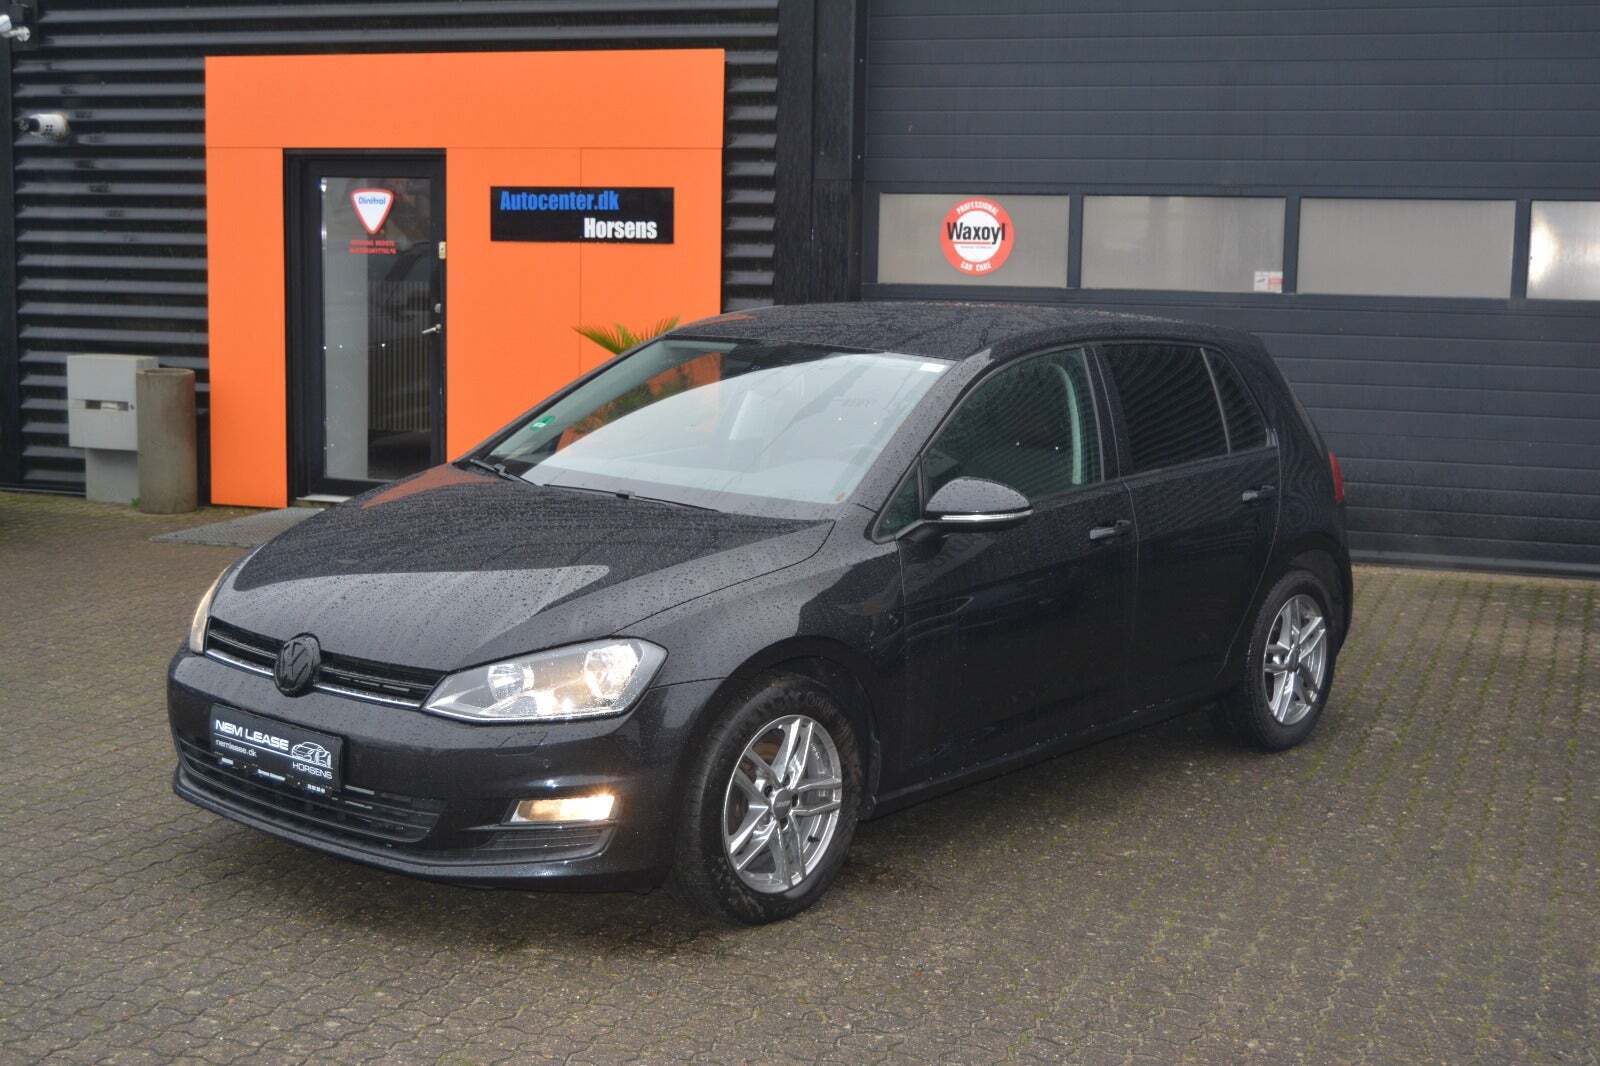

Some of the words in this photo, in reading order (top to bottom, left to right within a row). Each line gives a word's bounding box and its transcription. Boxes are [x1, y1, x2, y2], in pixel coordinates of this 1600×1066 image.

[500, 190, 620, 211] Autocenter.dk
[583, 217, 658, 239] Horsens
[946, 222, 1006, 245] Waxoyl
[215, 719, 244, 738] NEM
[245, 728, 289, 751] LEASE
[215, 739, 257, 757] nemlease.dk
[292, 761, 333, 780] HORSENS
